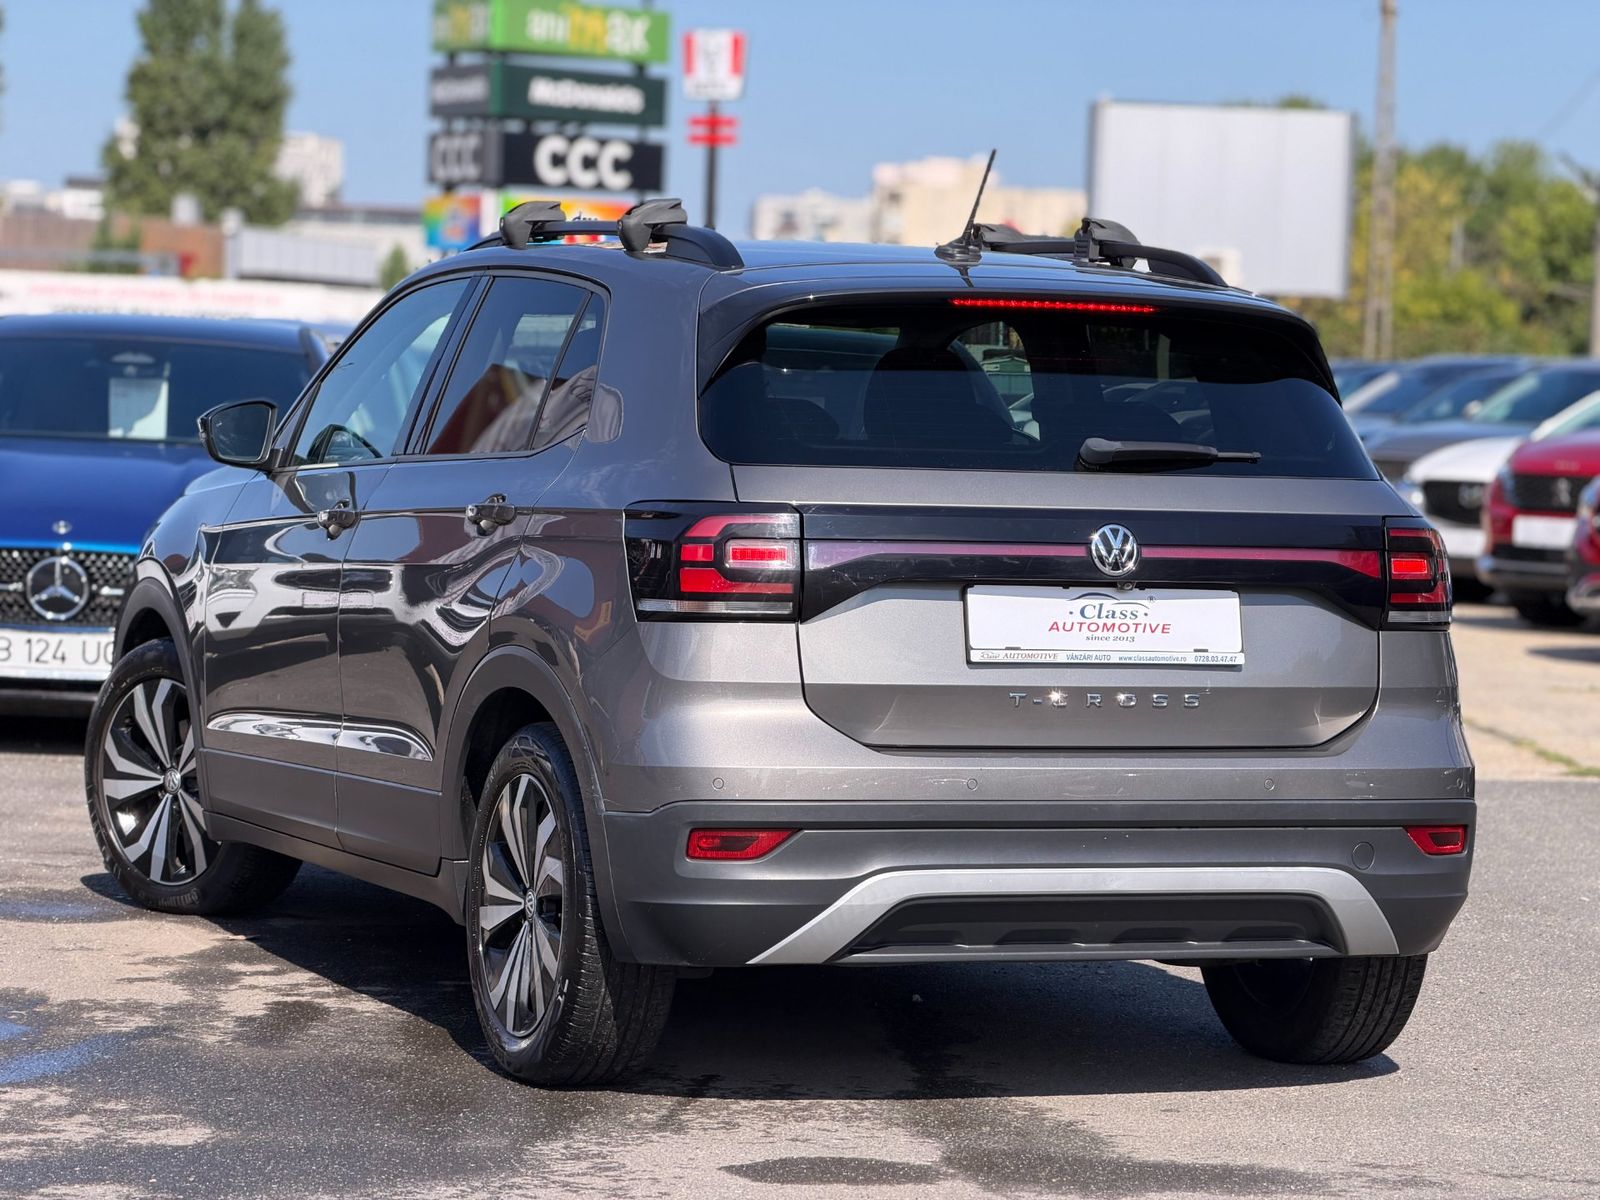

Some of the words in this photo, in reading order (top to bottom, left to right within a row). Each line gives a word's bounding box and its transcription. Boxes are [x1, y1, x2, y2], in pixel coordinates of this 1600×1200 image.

[534, 134, 634, 190] CCC
[1080, 603, 1139, 620] Class
[1048, 621, 1172, 634] AUTOMOTIVE
[1085, 634, 1111, 642] since
[1112, 634, 1136, 643] 2013
[25, 638, 67, 664] 124
[1002, 652, 1059, 660] AUTOMOTIVE
[1118, 655, 1188, 663] www.classautomotive.ro
[1194, 655, 1238, 663] 0728.03.47.47
